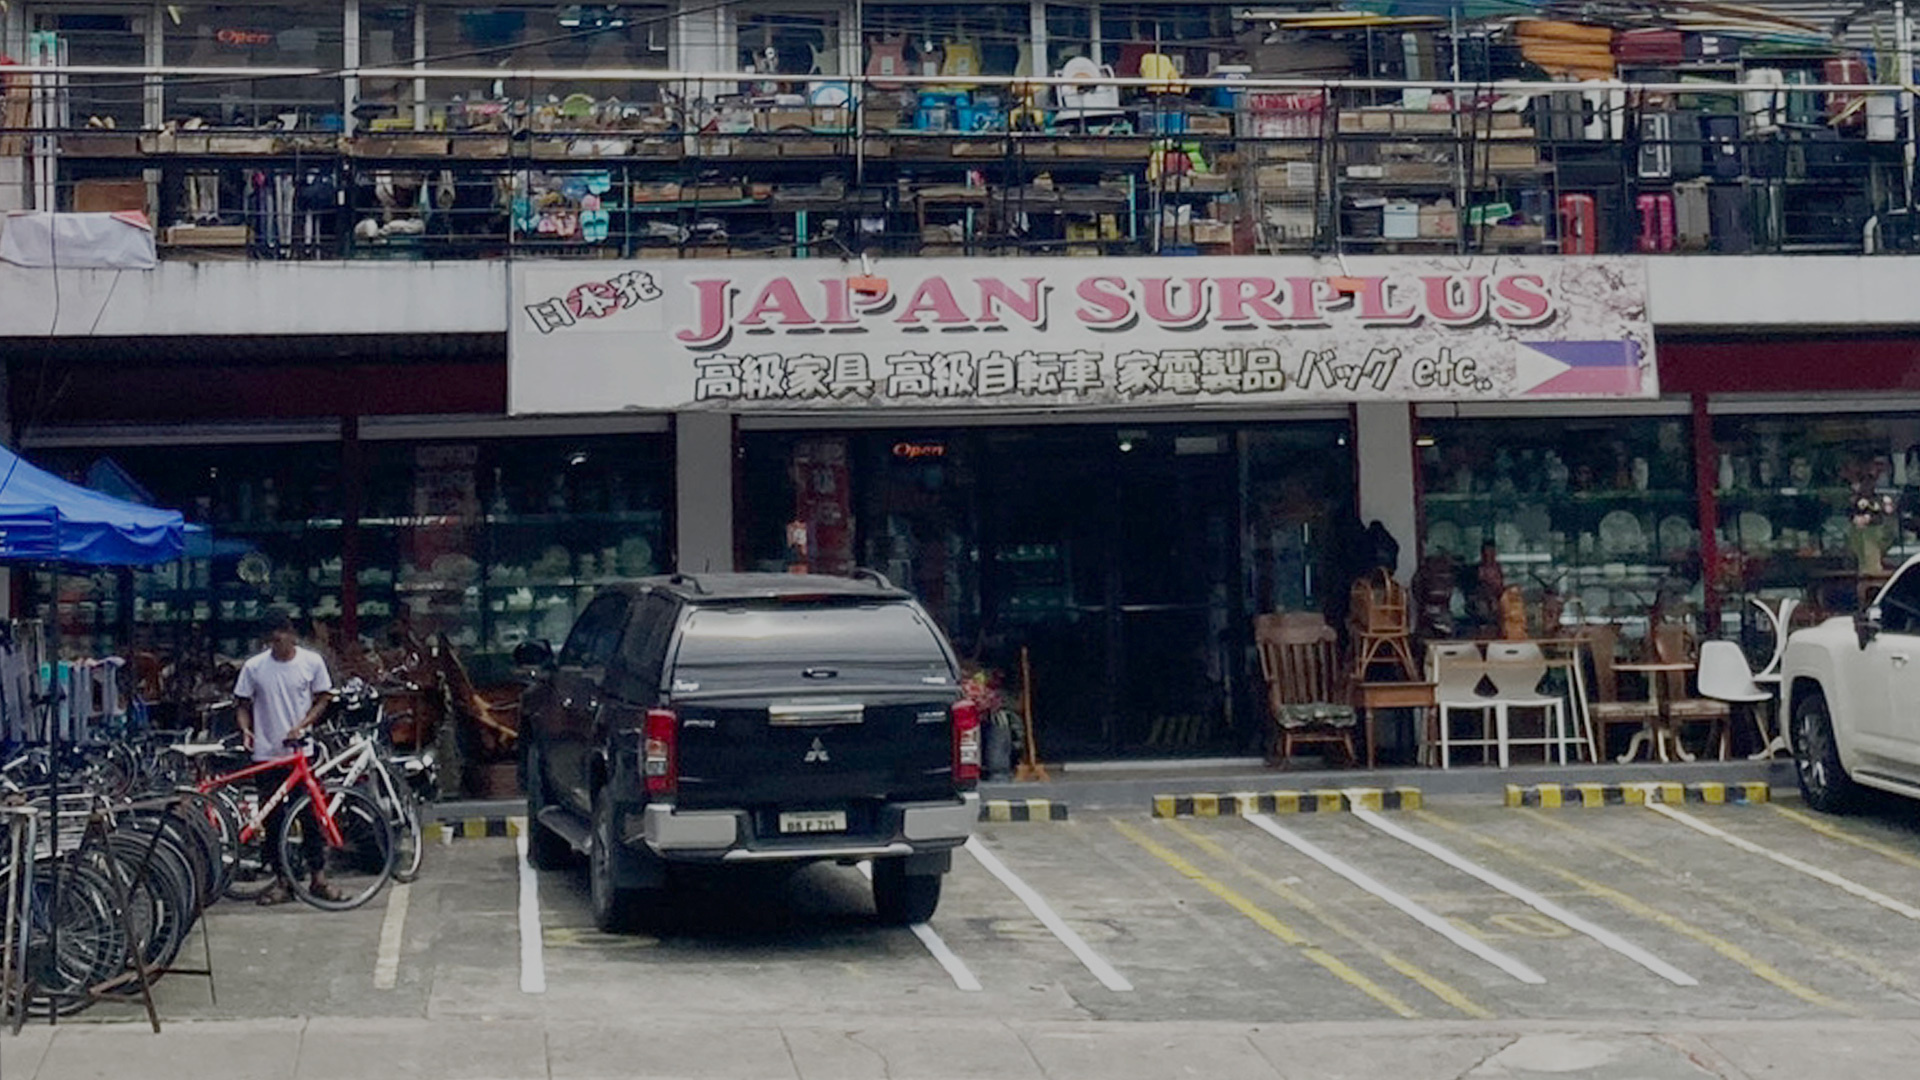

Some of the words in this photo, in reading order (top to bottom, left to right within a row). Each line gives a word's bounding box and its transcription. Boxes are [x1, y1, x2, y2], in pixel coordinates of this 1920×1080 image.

[217, 29, 271, 45] Open
[676, 276, 1053, 349] JAPAN
[1074, 274, 1557, 332] SURPLUS
[694, 352, 875, 400] 高級家具
[885, 349, 1104, 398] 高級自転車
[1115, 348, 1286, 395] 家電製品
[1296, 347, 1402, 391] バッグ
[892, 443, 944, 458] Open
